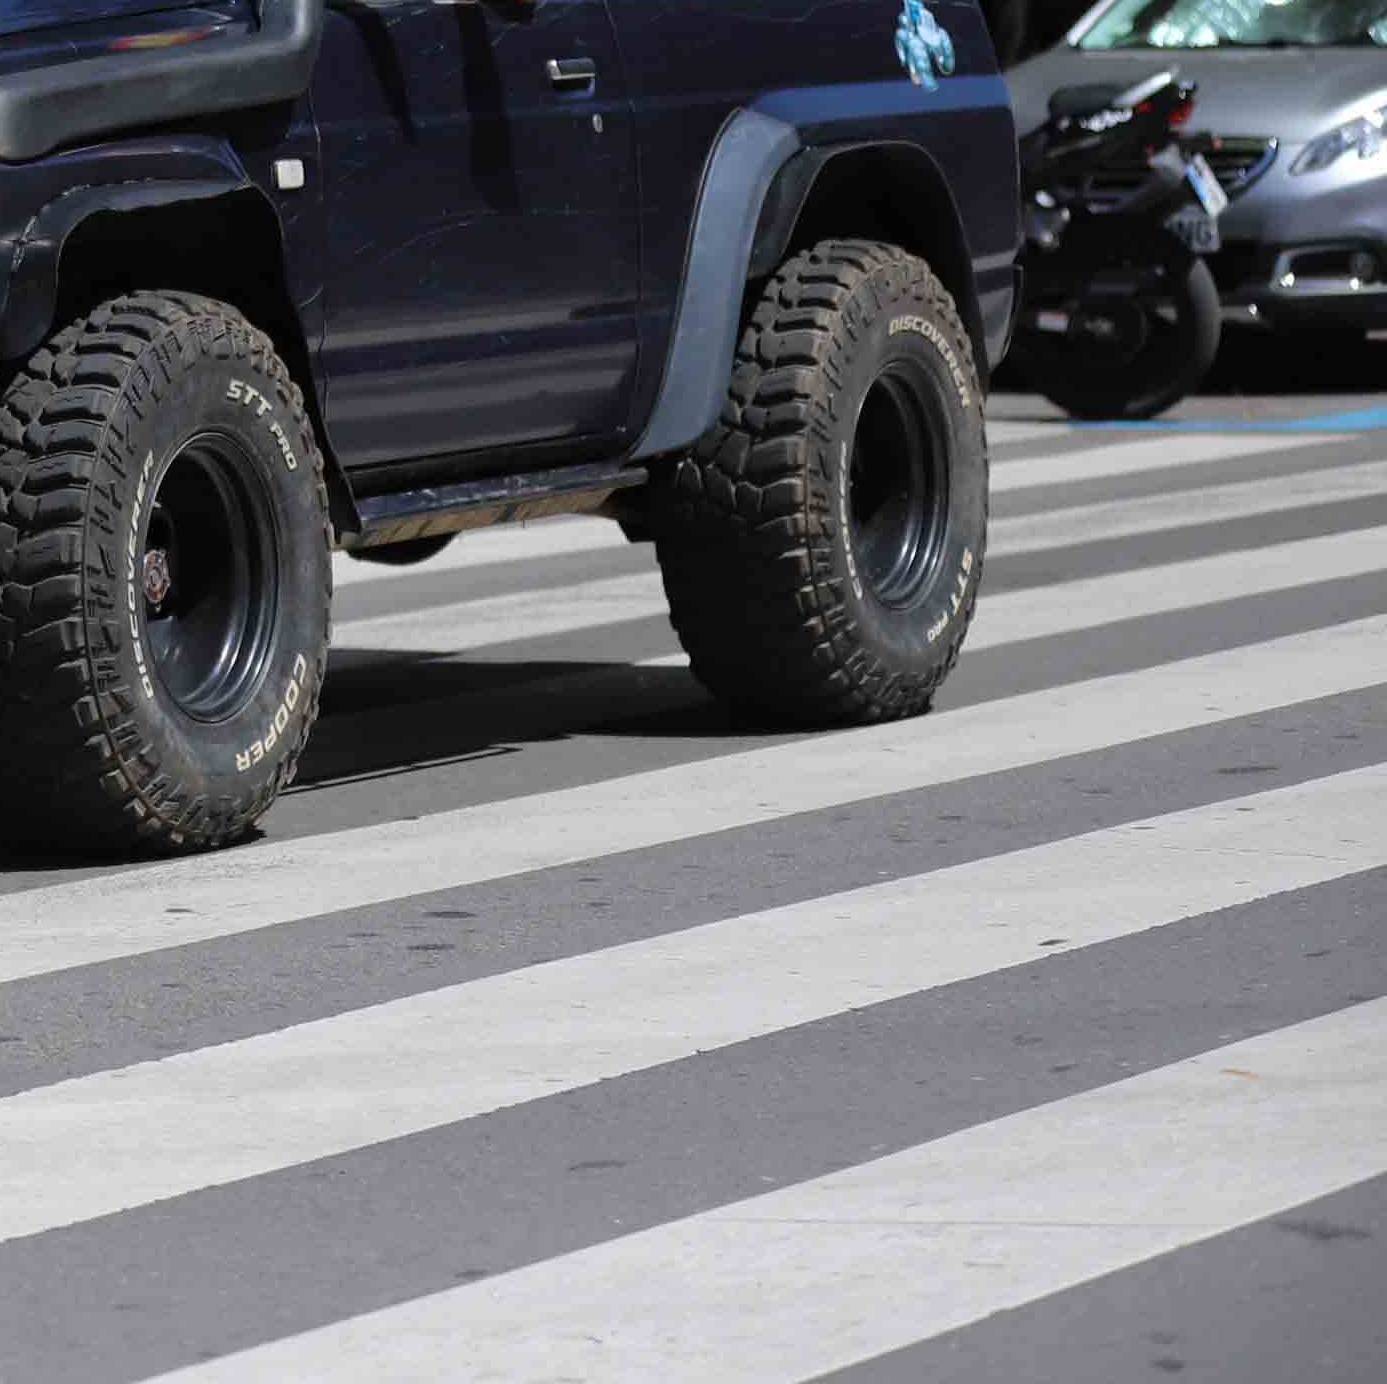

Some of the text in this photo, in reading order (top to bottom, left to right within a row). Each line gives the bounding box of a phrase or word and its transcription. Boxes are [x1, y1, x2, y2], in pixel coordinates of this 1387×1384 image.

[888, 315, 971, 408] DISCOVERER
[226, 378, 298, 470] STT PRO
[235, 653, 308, 772] COOPER
